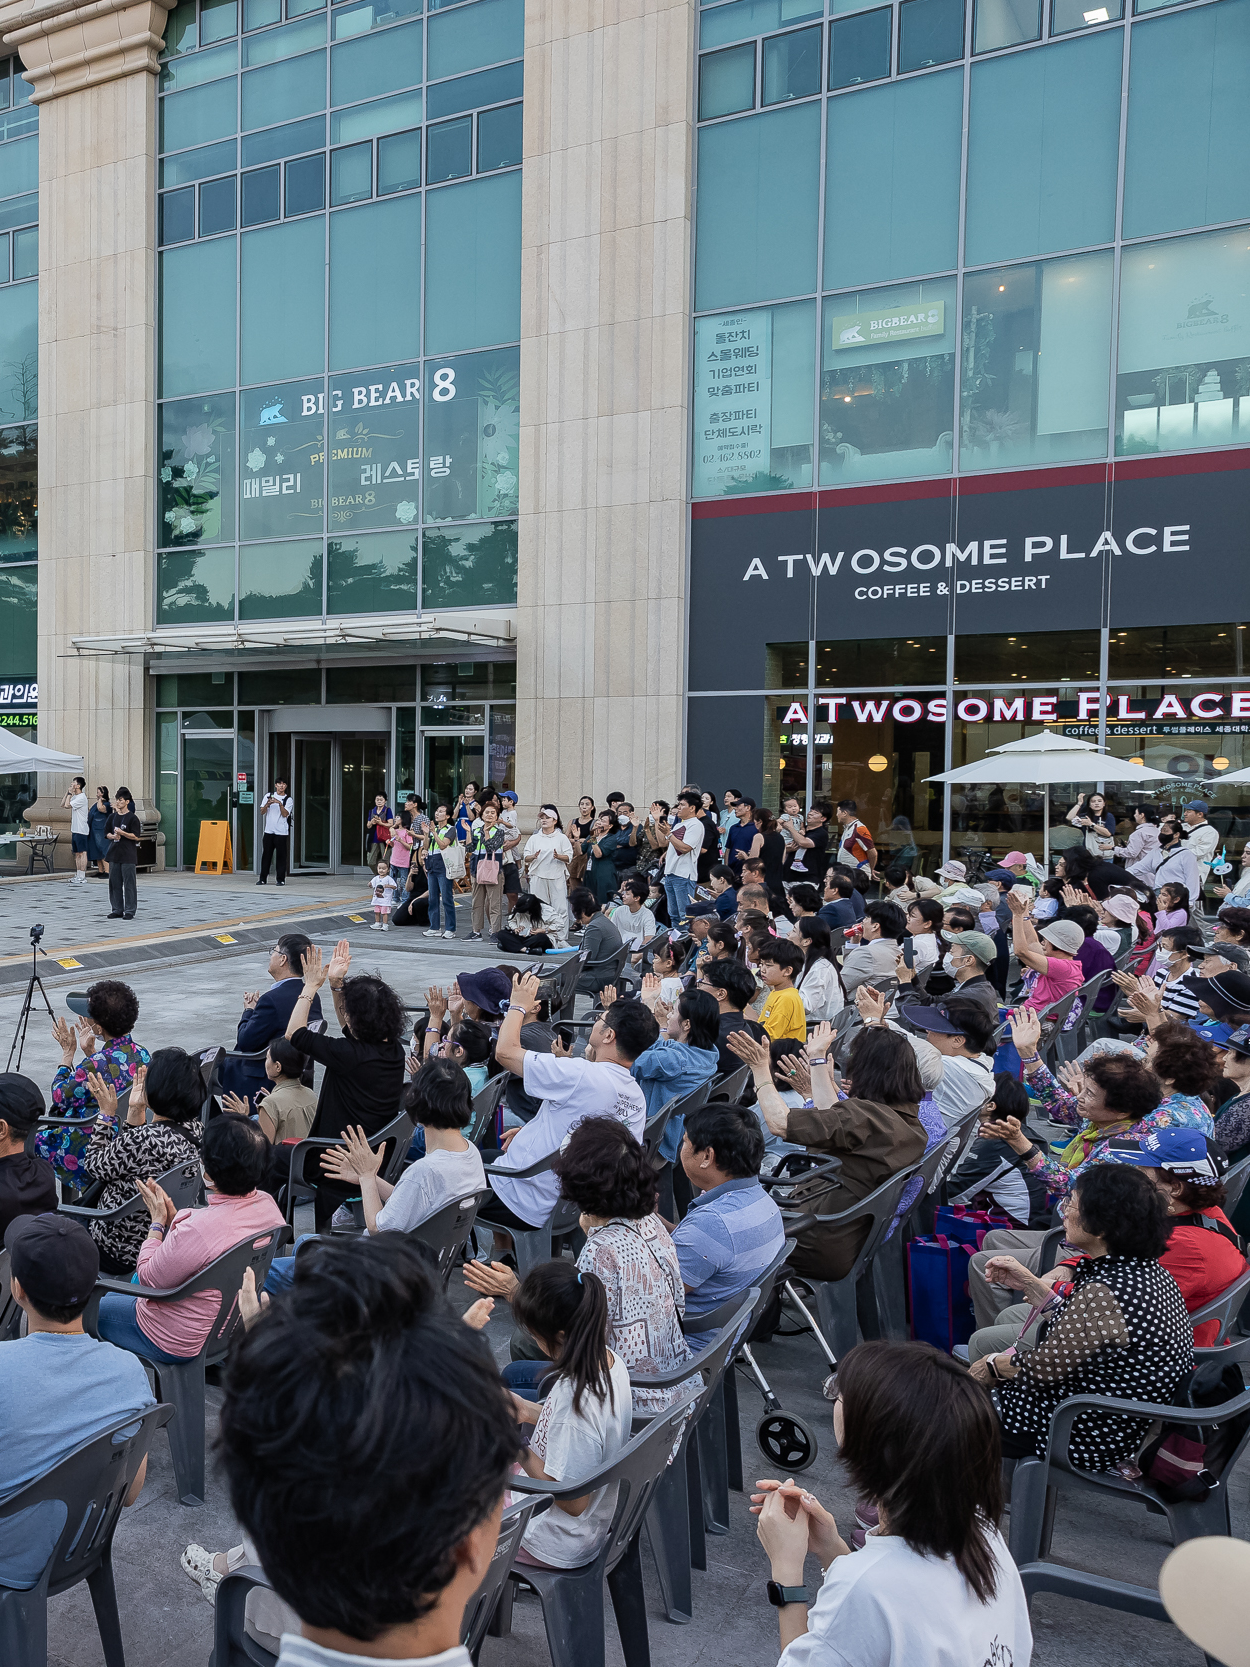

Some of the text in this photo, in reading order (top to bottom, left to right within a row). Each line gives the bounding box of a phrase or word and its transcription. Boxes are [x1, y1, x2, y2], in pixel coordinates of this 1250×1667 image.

[715, 329, 751, 345] 돌잔치
[706, 345, 759, 362] 스몰웨딩
[708, 364, 757, 380] 기업연회
[301, 367, 456, 417] BIG BEAR 8
[707, 381, 759, 398] 맞춤파티
[709, 408, 757, 424] 출장파티
[704, 424, 763, 440] 단체도시락
[310, 447, 373, 466] PREMIUM
[702, 449, 762, 464] 02.462.8802
[360, 454, 453, 486] 레스토랑
[243, 473, 301, 499] 패밀리
[743, 524, 1191, 581] A TWOSOME PLACE
[854, 575, 1050, 600] COFFEE & DESSERT
[782, 691, 1250, 724] A TWOSOME PLACE
[1065, 725, 1101, 735] coffee
[1113, 725, 1158, 735] dessert
[1162, 726, 1212, 734] 투썸플레이스
[1155, 782, 1193, 796] TWOSOME
[1193, 783, 1218, 800] PLACE
